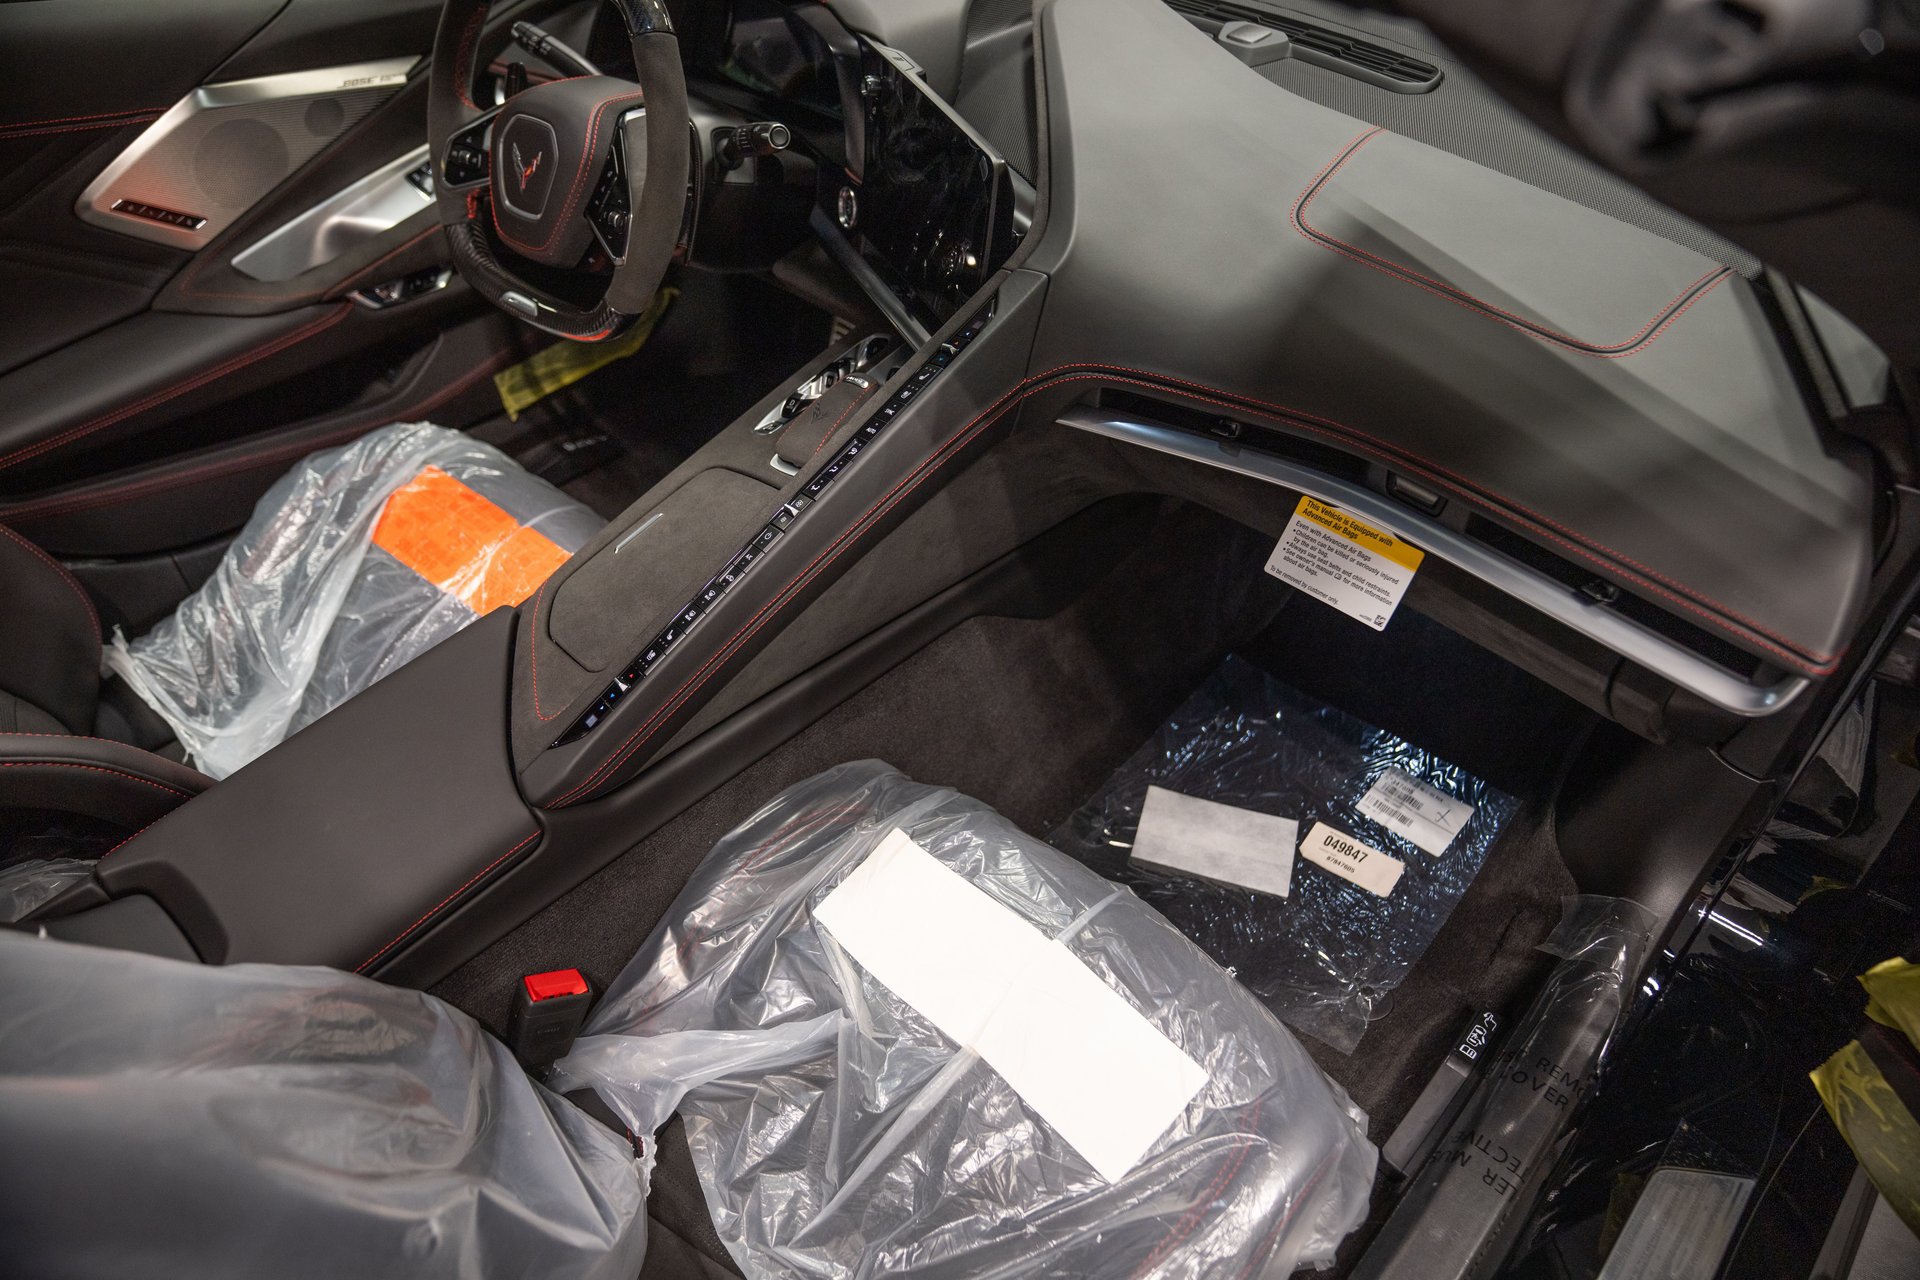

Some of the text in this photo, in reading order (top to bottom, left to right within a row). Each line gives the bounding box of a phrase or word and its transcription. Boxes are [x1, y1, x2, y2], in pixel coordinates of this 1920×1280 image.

[1295, 520, 1371, 562] Even with Advanced Air Bags
[1302, 508, 1358, 539] Advanced Air Bags
[1307, 499, 1393, 547] This Vehicle is Equipped with
[1283, 555, 1298, 566] about
[1304, 565, 1317, 576] bags.
[1293, 536, 1301, 544] by
[1300, 540, 1310, 548] the
[1317, 548, 1328, 558] bag.
[1295, 529, 1317, 544] Children
[1316, 540, 1327, 549] can
[1334, 548, 1349, 560] killed
[1355, 560, 1380, 575] seriously
[1379, 571, 1399, 585] injured
[1281, 572, 1302, 585] removed
[1300, 581, 1308, 589] by
[1307, 585, 1328, 598] customer
[1327, 596, 1338, 604] only.
[1285, 547, 1392, 605] See owner's manual for more information
[1288, 542, 1390, 597] Always use seat belts and child restraints.
[1323, 835, 1368, 863] 049847
